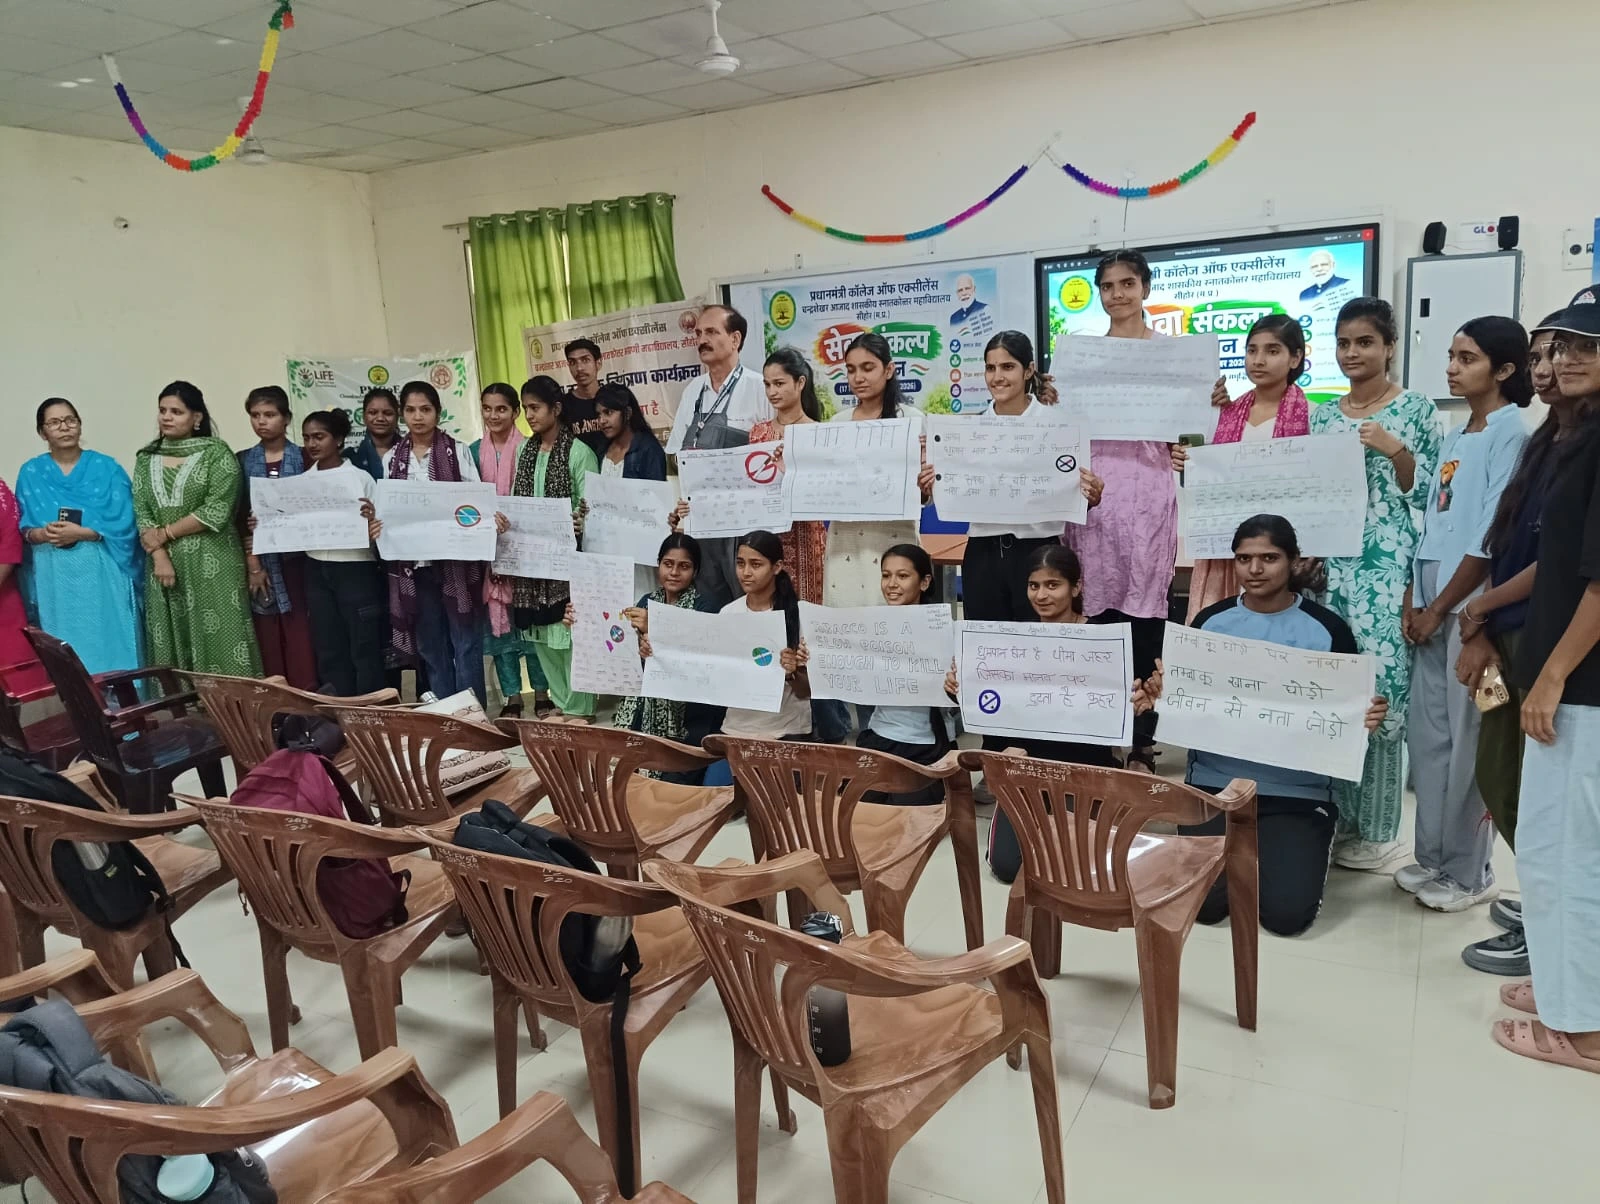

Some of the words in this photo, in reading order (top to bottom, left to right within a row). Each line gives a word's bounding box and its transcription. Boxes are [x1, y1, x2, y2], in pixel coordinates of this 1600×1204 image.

[1473, 225, 1499, 234] GLO
[1164, 263, 1199, 278] कॉलेज
[1202, 260, 1228, 275] ऑफ
[1231, 256, 1286, 272] एक्सीलेंस
[810, 285, 846, 301] प्रधानमंत्री
[848, 283, 874, 299] कॉलेज
[877, 281, 896, 296] ऑफ
[898, 278, 938, 294] एक्सीलेंस
[830, 302, 850, 312] आजाद
[851, 298, 877, 310] शासकीय
[913, 293, 951, 306] महाविद्यालय
[856, 310, 872, 320] सीहोर
[874, 621, 889, 635] IS
[900, 621, 913, 635] A
[818, 653, 875, 670] ENOUGH
[881, 655, 900, 672] TO
[908, 656, 945, 675] KILL
[874, 675, 920, 695] LIFE
[1228, 675, 1269, 693] खाना
[1223, 695, 1249, 720] से
